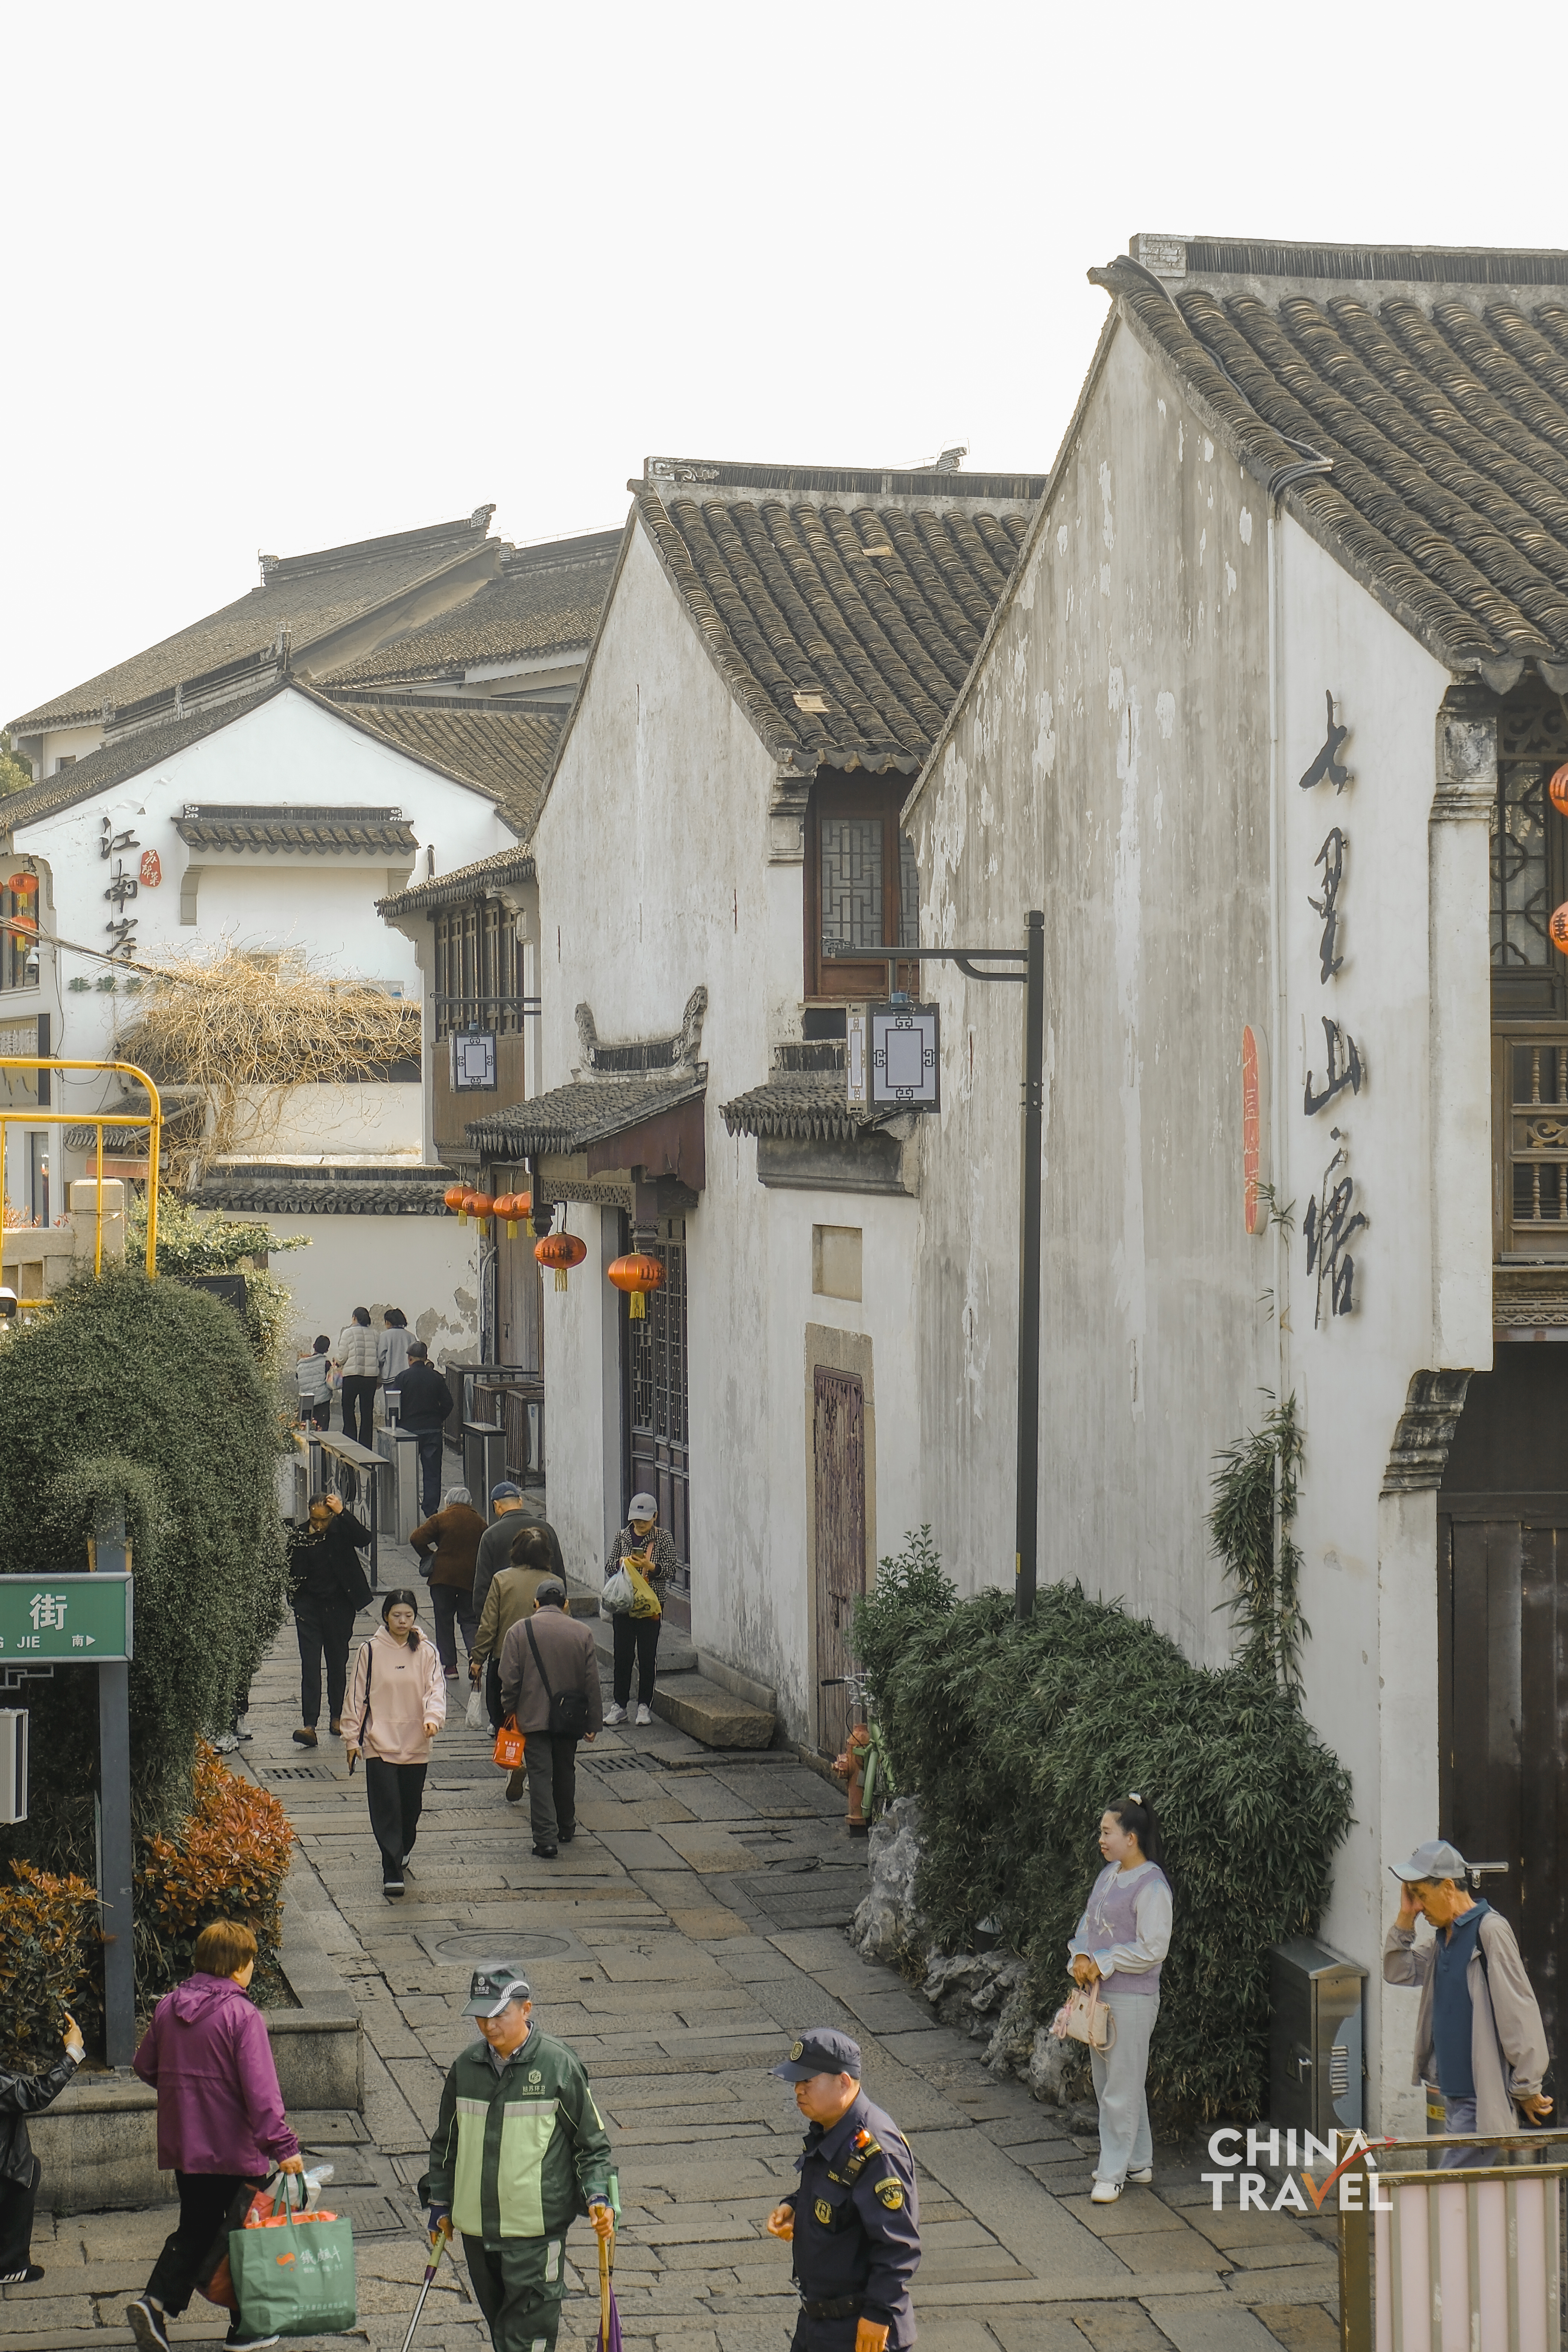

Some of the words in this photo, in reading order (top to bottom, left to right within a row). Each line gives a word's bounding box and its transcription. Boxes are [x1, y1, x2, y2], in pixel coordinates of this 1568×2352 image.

[141, 850, 159, 886] 苏帮菜
[100, 816, 141, 959] 江南岸
[543, 1245, 573, 1260] 山塘
[29, 1593, 67, 1631] 街
[17, 1636, 40, 1648] JIE
[72, 1634, 84, 1647] 南
